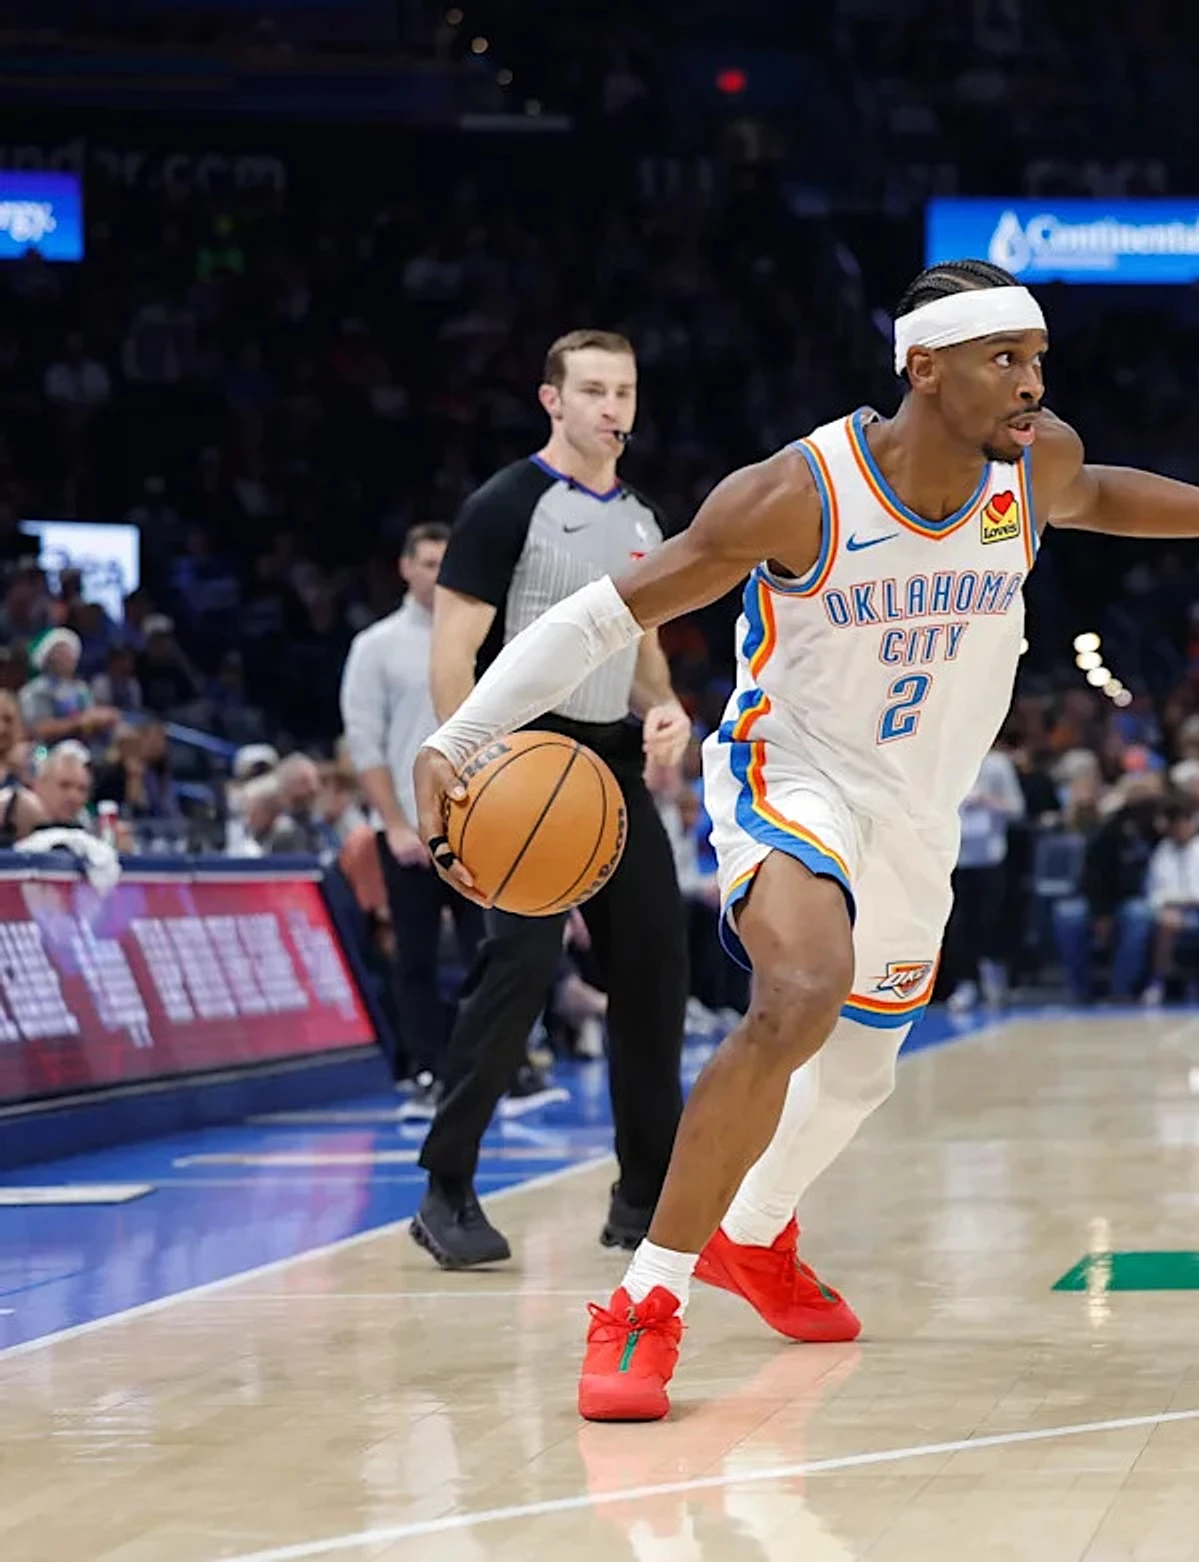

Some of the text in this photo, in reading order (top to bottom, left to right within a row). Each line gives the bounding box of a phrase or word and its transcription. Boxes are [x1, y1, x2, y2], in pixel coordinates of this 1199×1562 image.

[823, 570, 1023, 627] OKLAHOMA
[879, 621, 969, 667] CITY
[876, 671, 933, 745] 2
